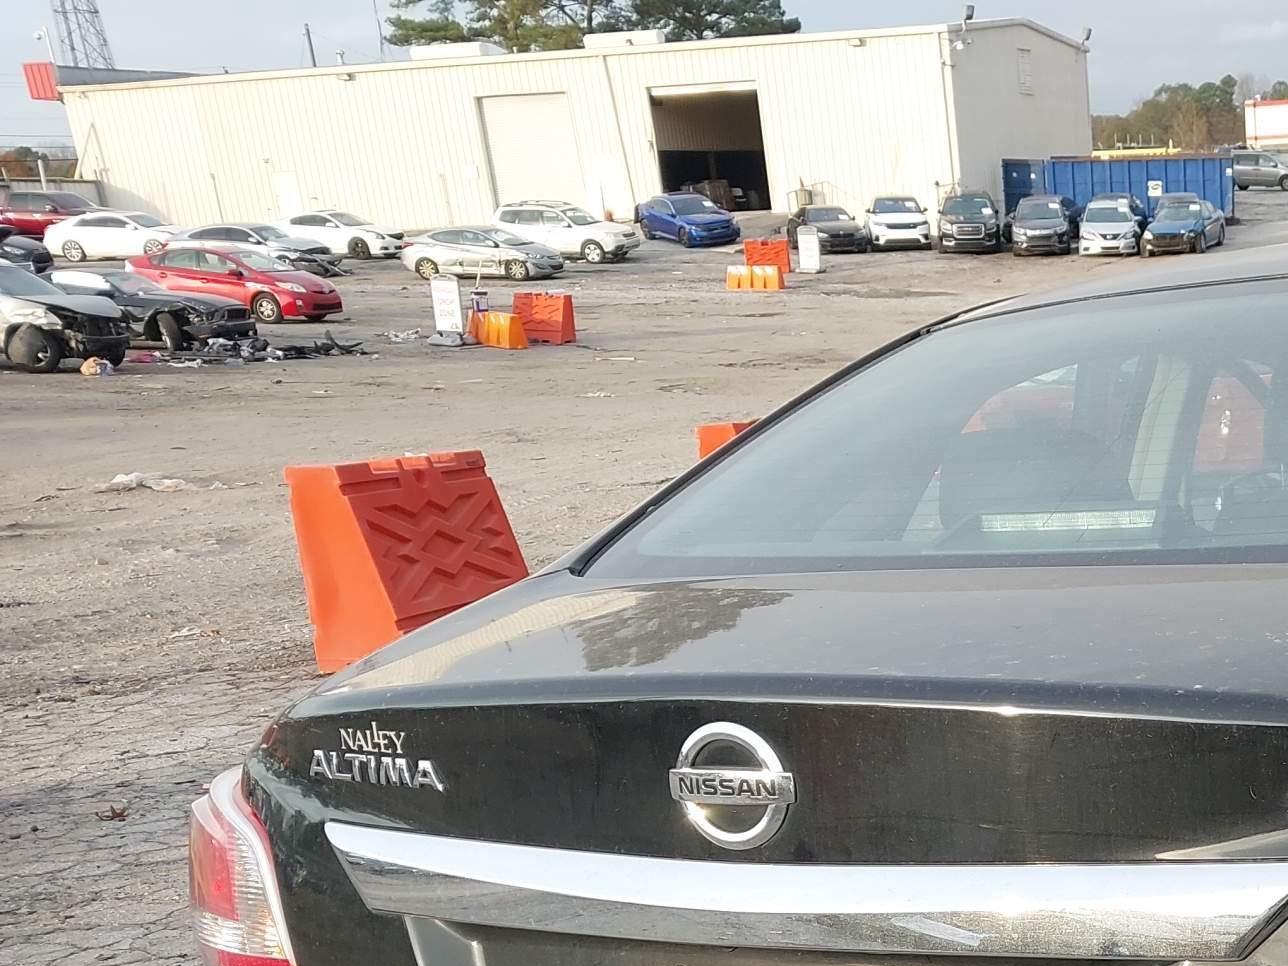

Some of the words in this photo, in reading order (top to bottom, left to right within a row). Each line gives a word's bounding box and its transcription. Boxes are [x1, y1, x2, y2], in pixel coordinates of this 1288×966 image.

[339, 721, 405, 754] NALLEY
[309, 749, 444, 792] ALTIMA
[678, 776, 777, 797] NISSAN
